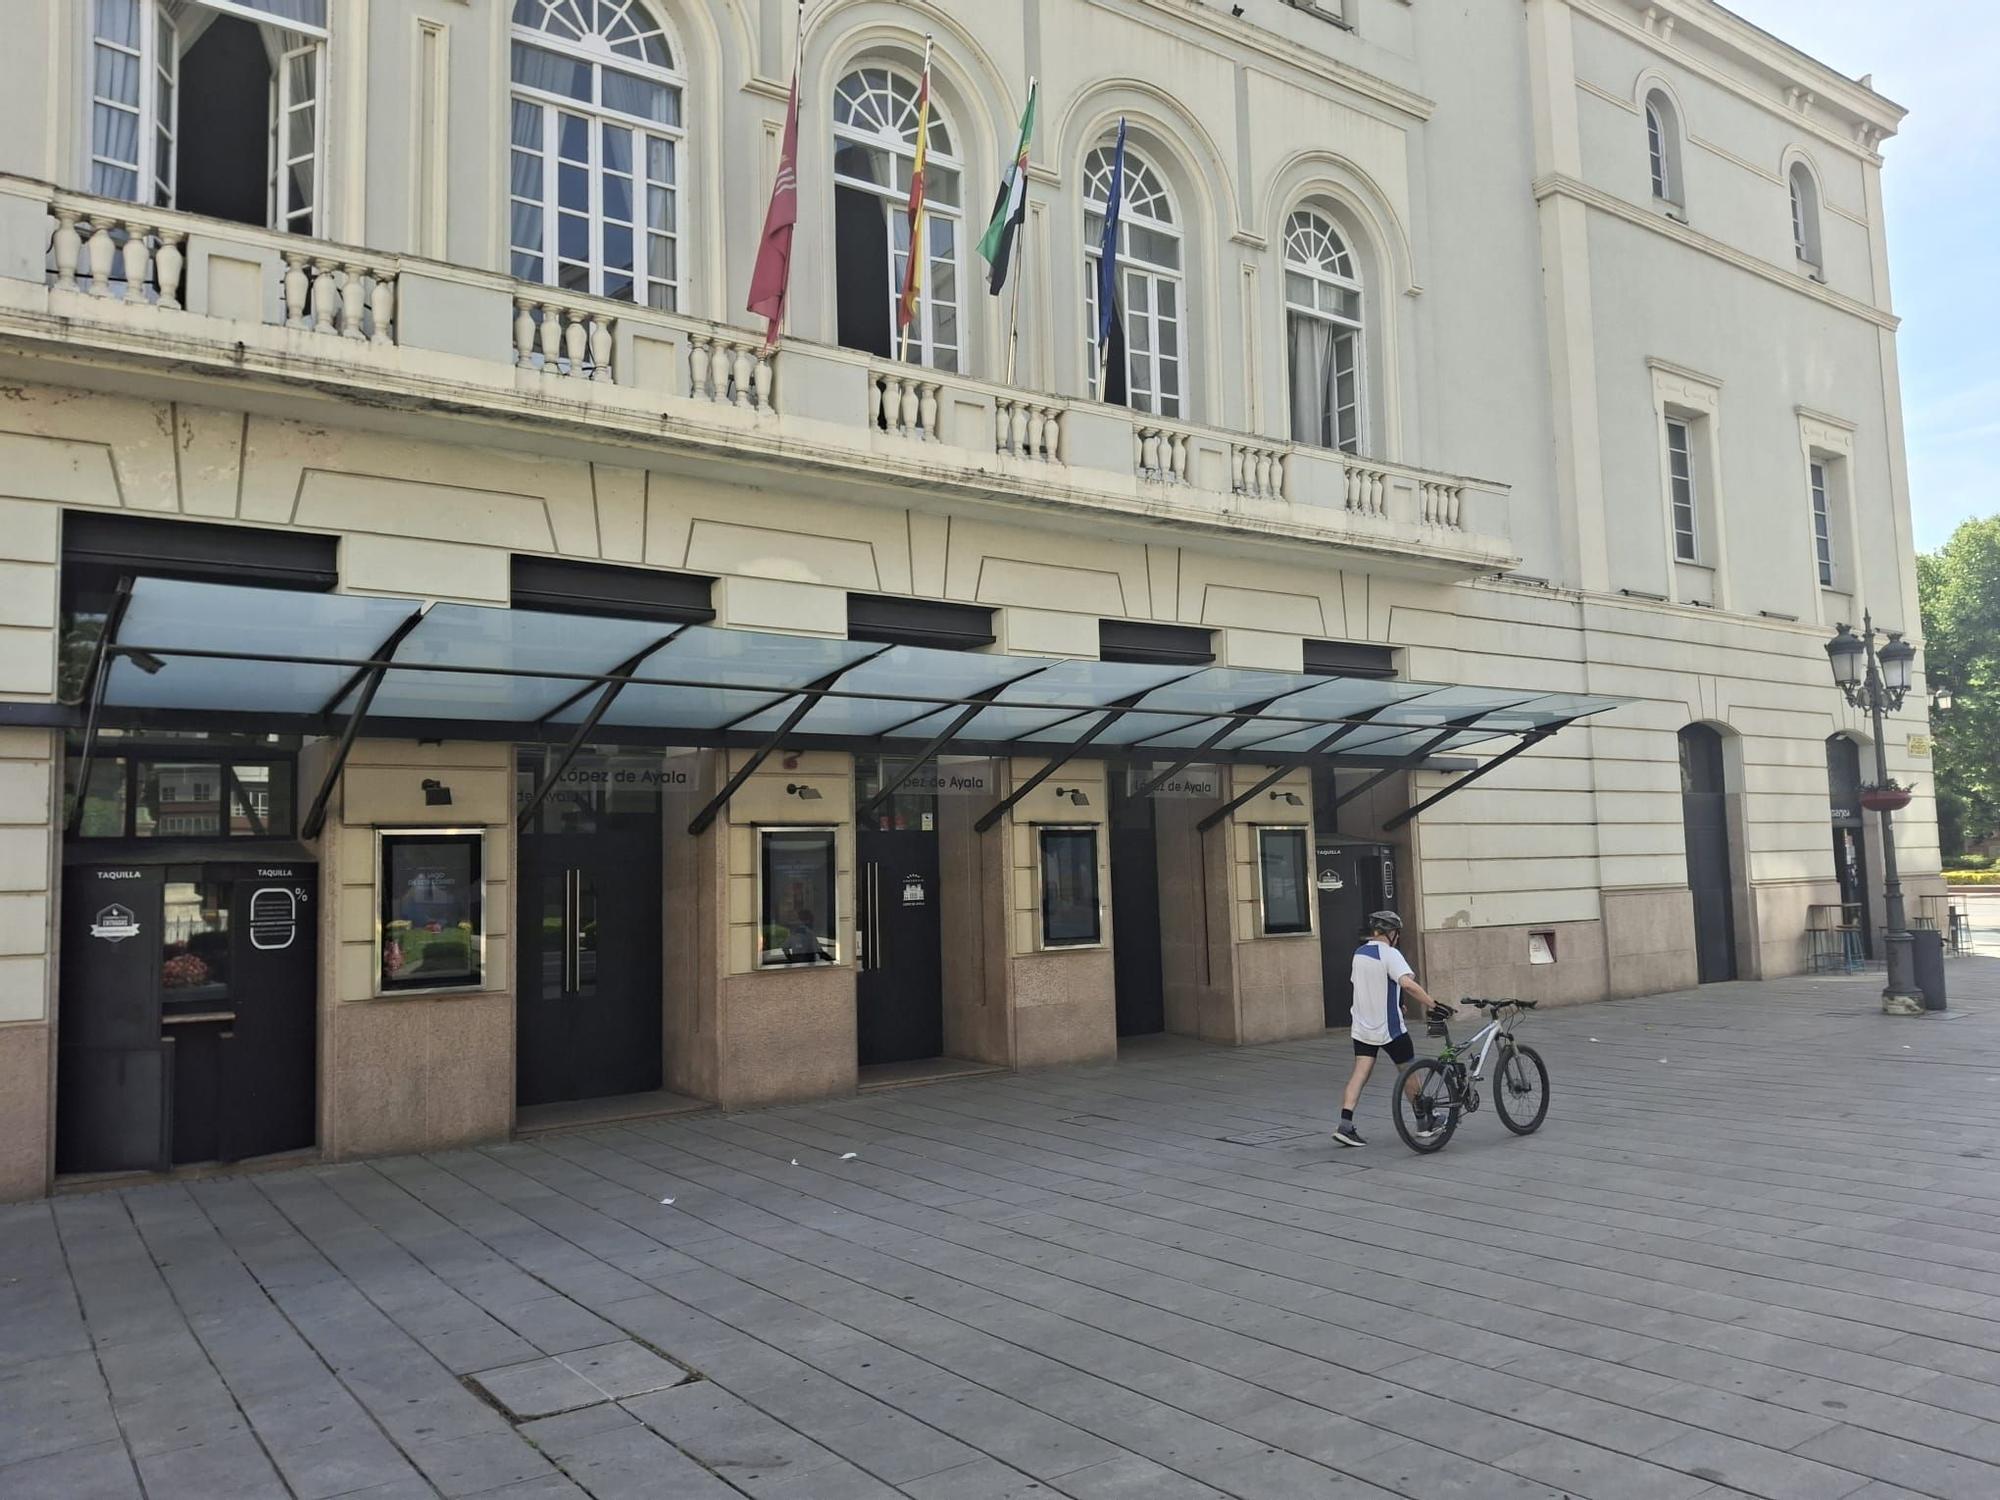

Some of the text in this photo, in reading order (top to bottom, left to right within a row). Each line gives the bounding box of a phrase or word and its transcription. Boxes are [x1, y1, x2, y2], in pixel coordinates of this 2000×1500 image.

[614, 769, 637, 783] de
[640, 770, 688, 786] Ayala
[930, 776, 946, 788] de
[949, 776, 984, 790] Ayala
[1167, 782, 1181, 792] de
[1183, 781, 1212, 793] Ayala
[97, 871, 141, 880] TAQUILLA
[257, 869, 293, 878] TAQUILLA
